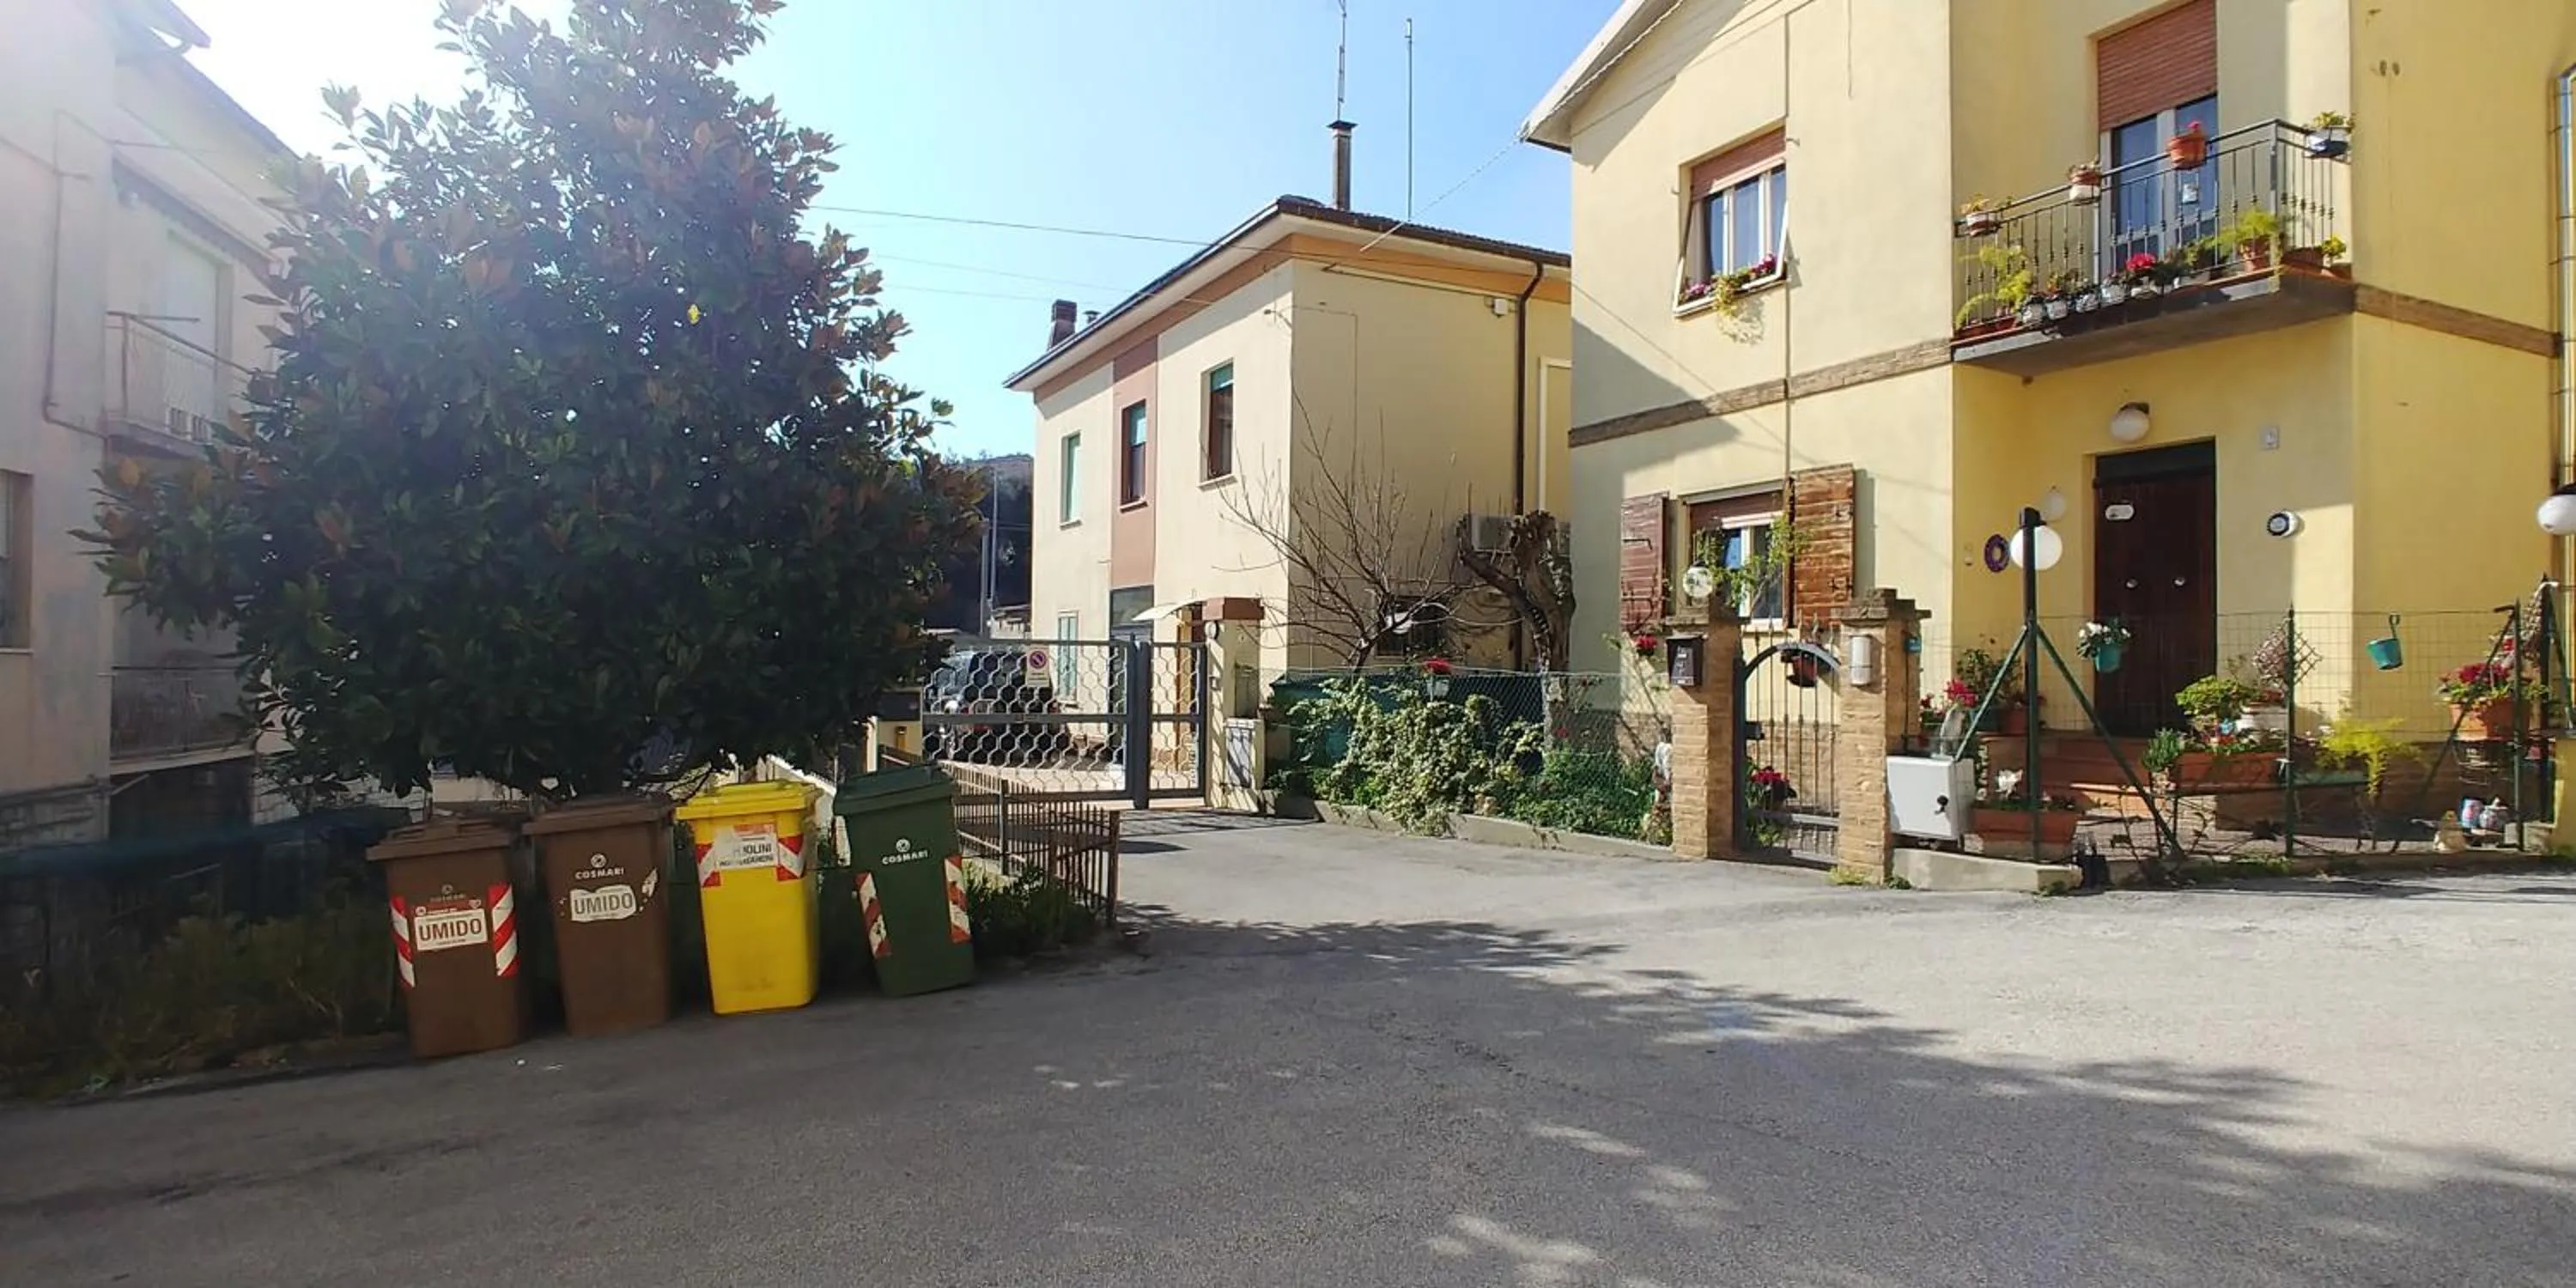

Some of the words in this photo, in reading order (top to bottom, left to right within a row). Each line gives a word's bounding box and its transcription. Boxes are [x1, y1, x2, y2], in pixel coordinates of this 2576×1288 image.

[881, 849, 928, 865] COSMARI
[574, 866, 624, 880] COSMARI
[574, 892, 633, 914] UMIDO
[418, 918, 482, 942] UMIDO
